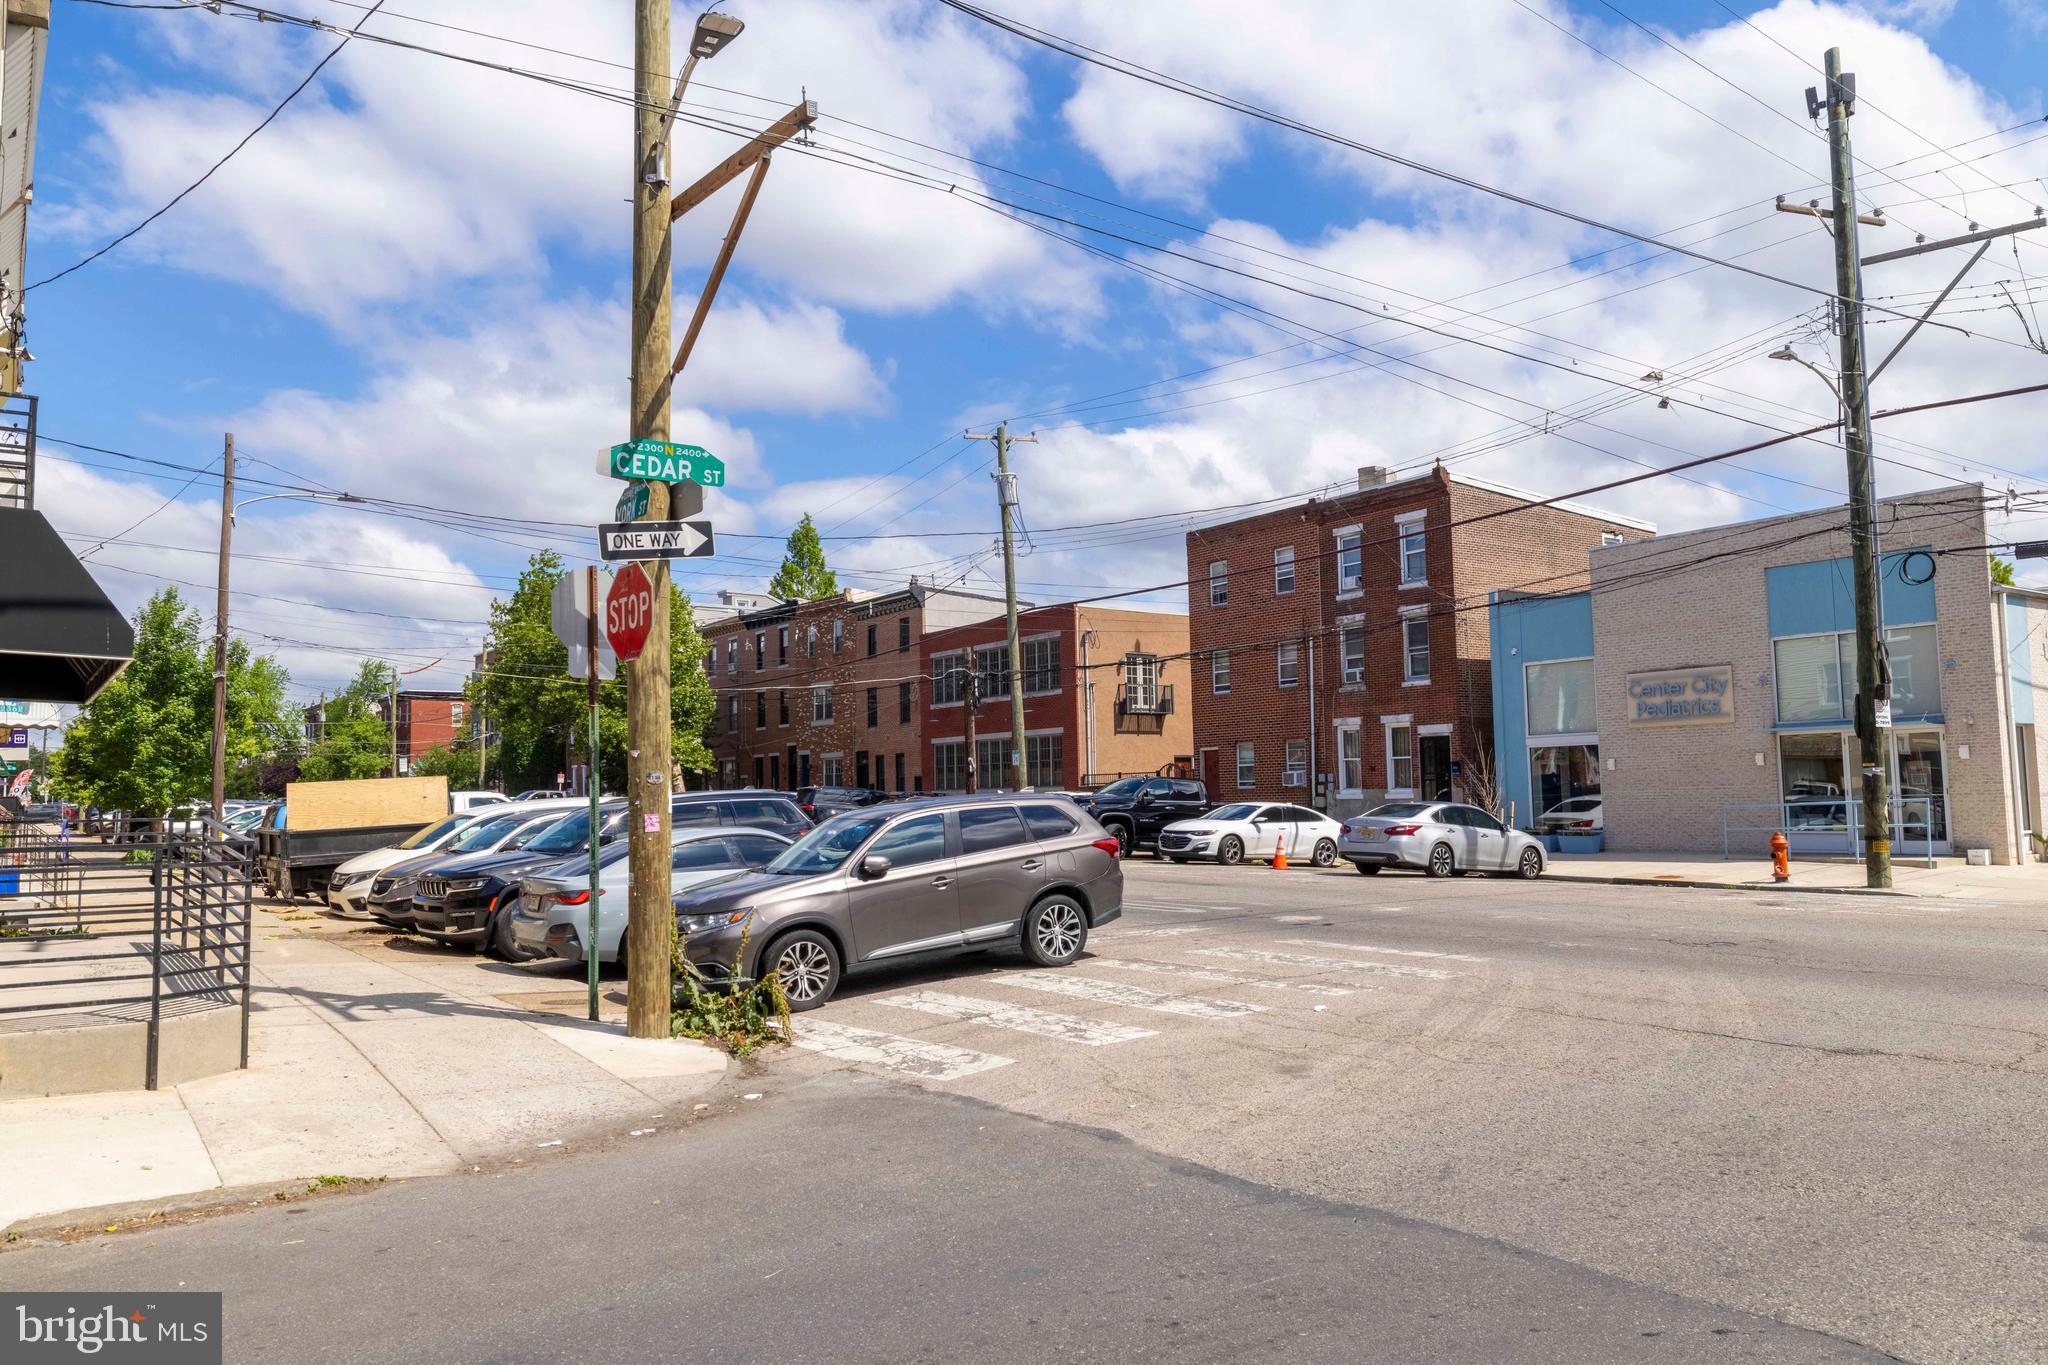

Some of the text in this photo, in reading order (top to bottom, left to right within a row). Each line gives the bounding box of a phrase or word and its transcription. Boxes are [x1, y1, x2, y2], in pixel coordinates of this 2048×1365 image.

[637, 443, 701, 458] 2300 N 2400
[616, 452, 721, 484] CEDAR ST
[616, 500, 647, 522] YORK ST
[613, 532, 680, 549] ONE WAY
[609, 591, 650, 635] STOP
[1628, 674, 1728, 699] Center City
[1635, 698, 1722, 719] Pediatrics
